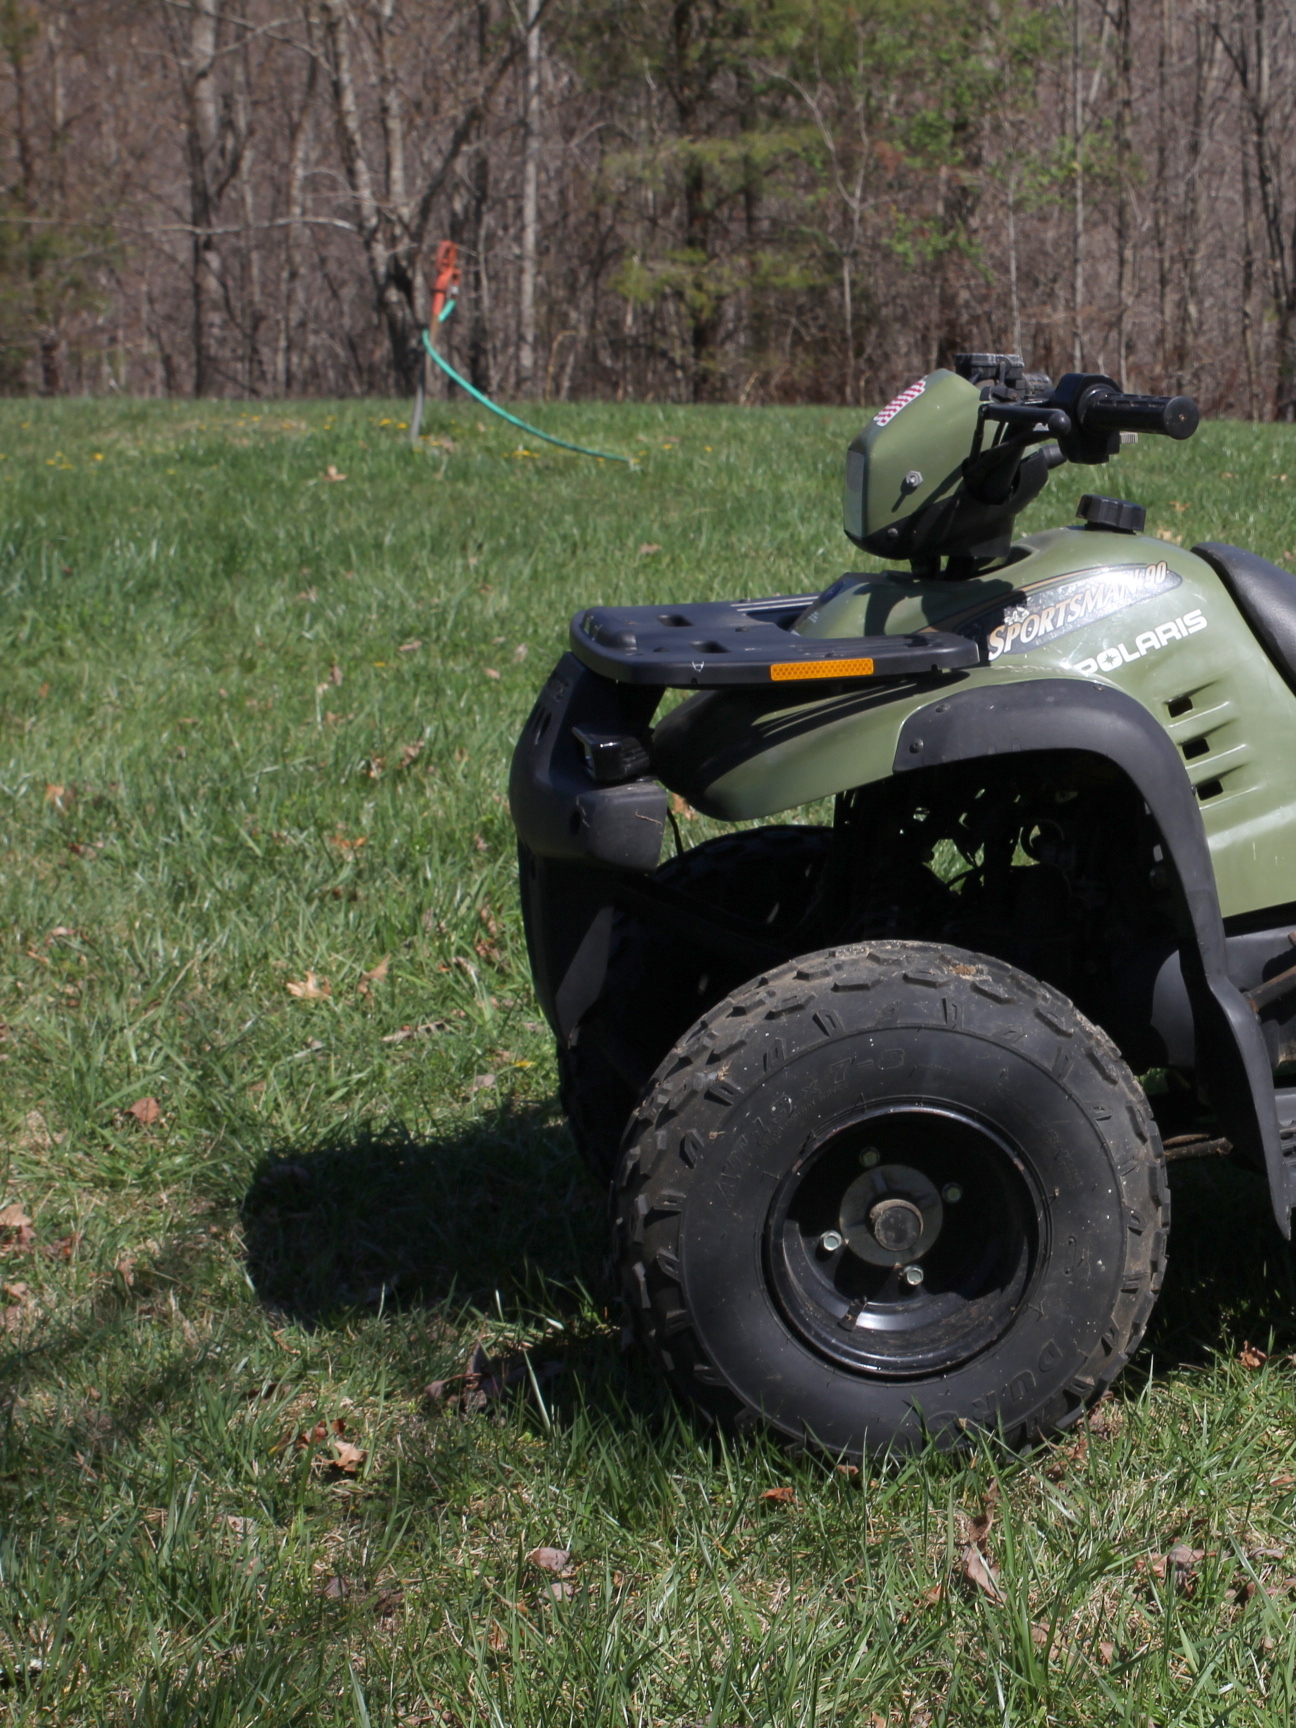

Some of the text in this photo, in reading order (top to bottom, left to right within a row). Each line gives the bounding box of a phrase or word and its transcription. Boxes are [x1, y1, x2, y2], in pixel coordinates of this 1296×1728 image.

[987, 561, 1168, 661] SPORTSMAN 90
[1073, 609, 1208, 675] POLARIS
